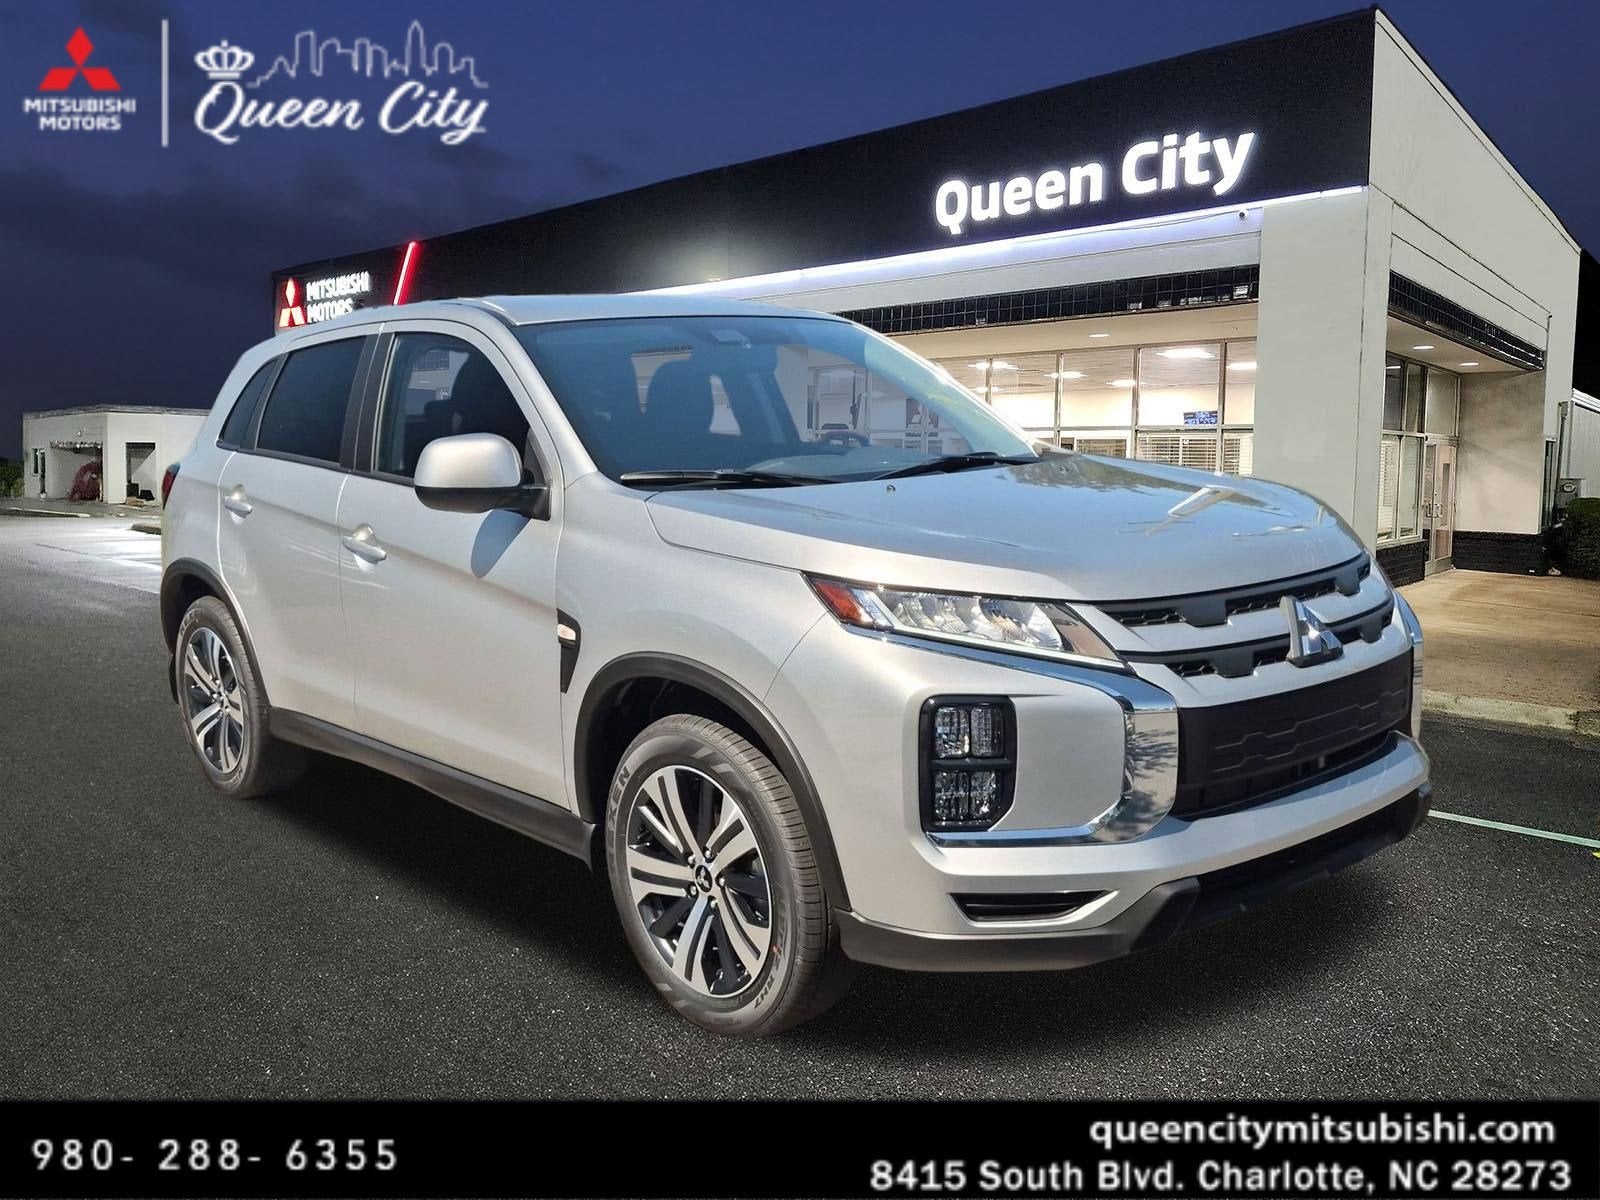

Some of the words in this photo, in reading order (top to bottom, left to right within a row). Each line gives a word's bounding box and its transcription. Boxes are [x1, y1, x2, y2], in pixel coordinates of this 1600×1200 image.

[935, 161, 1103, 235] Queen
[1121, 131, 1255, 196] City
[305, 270, 370, 302] MITSUBISHI
[306, 297, 354, 324] MOTORS
